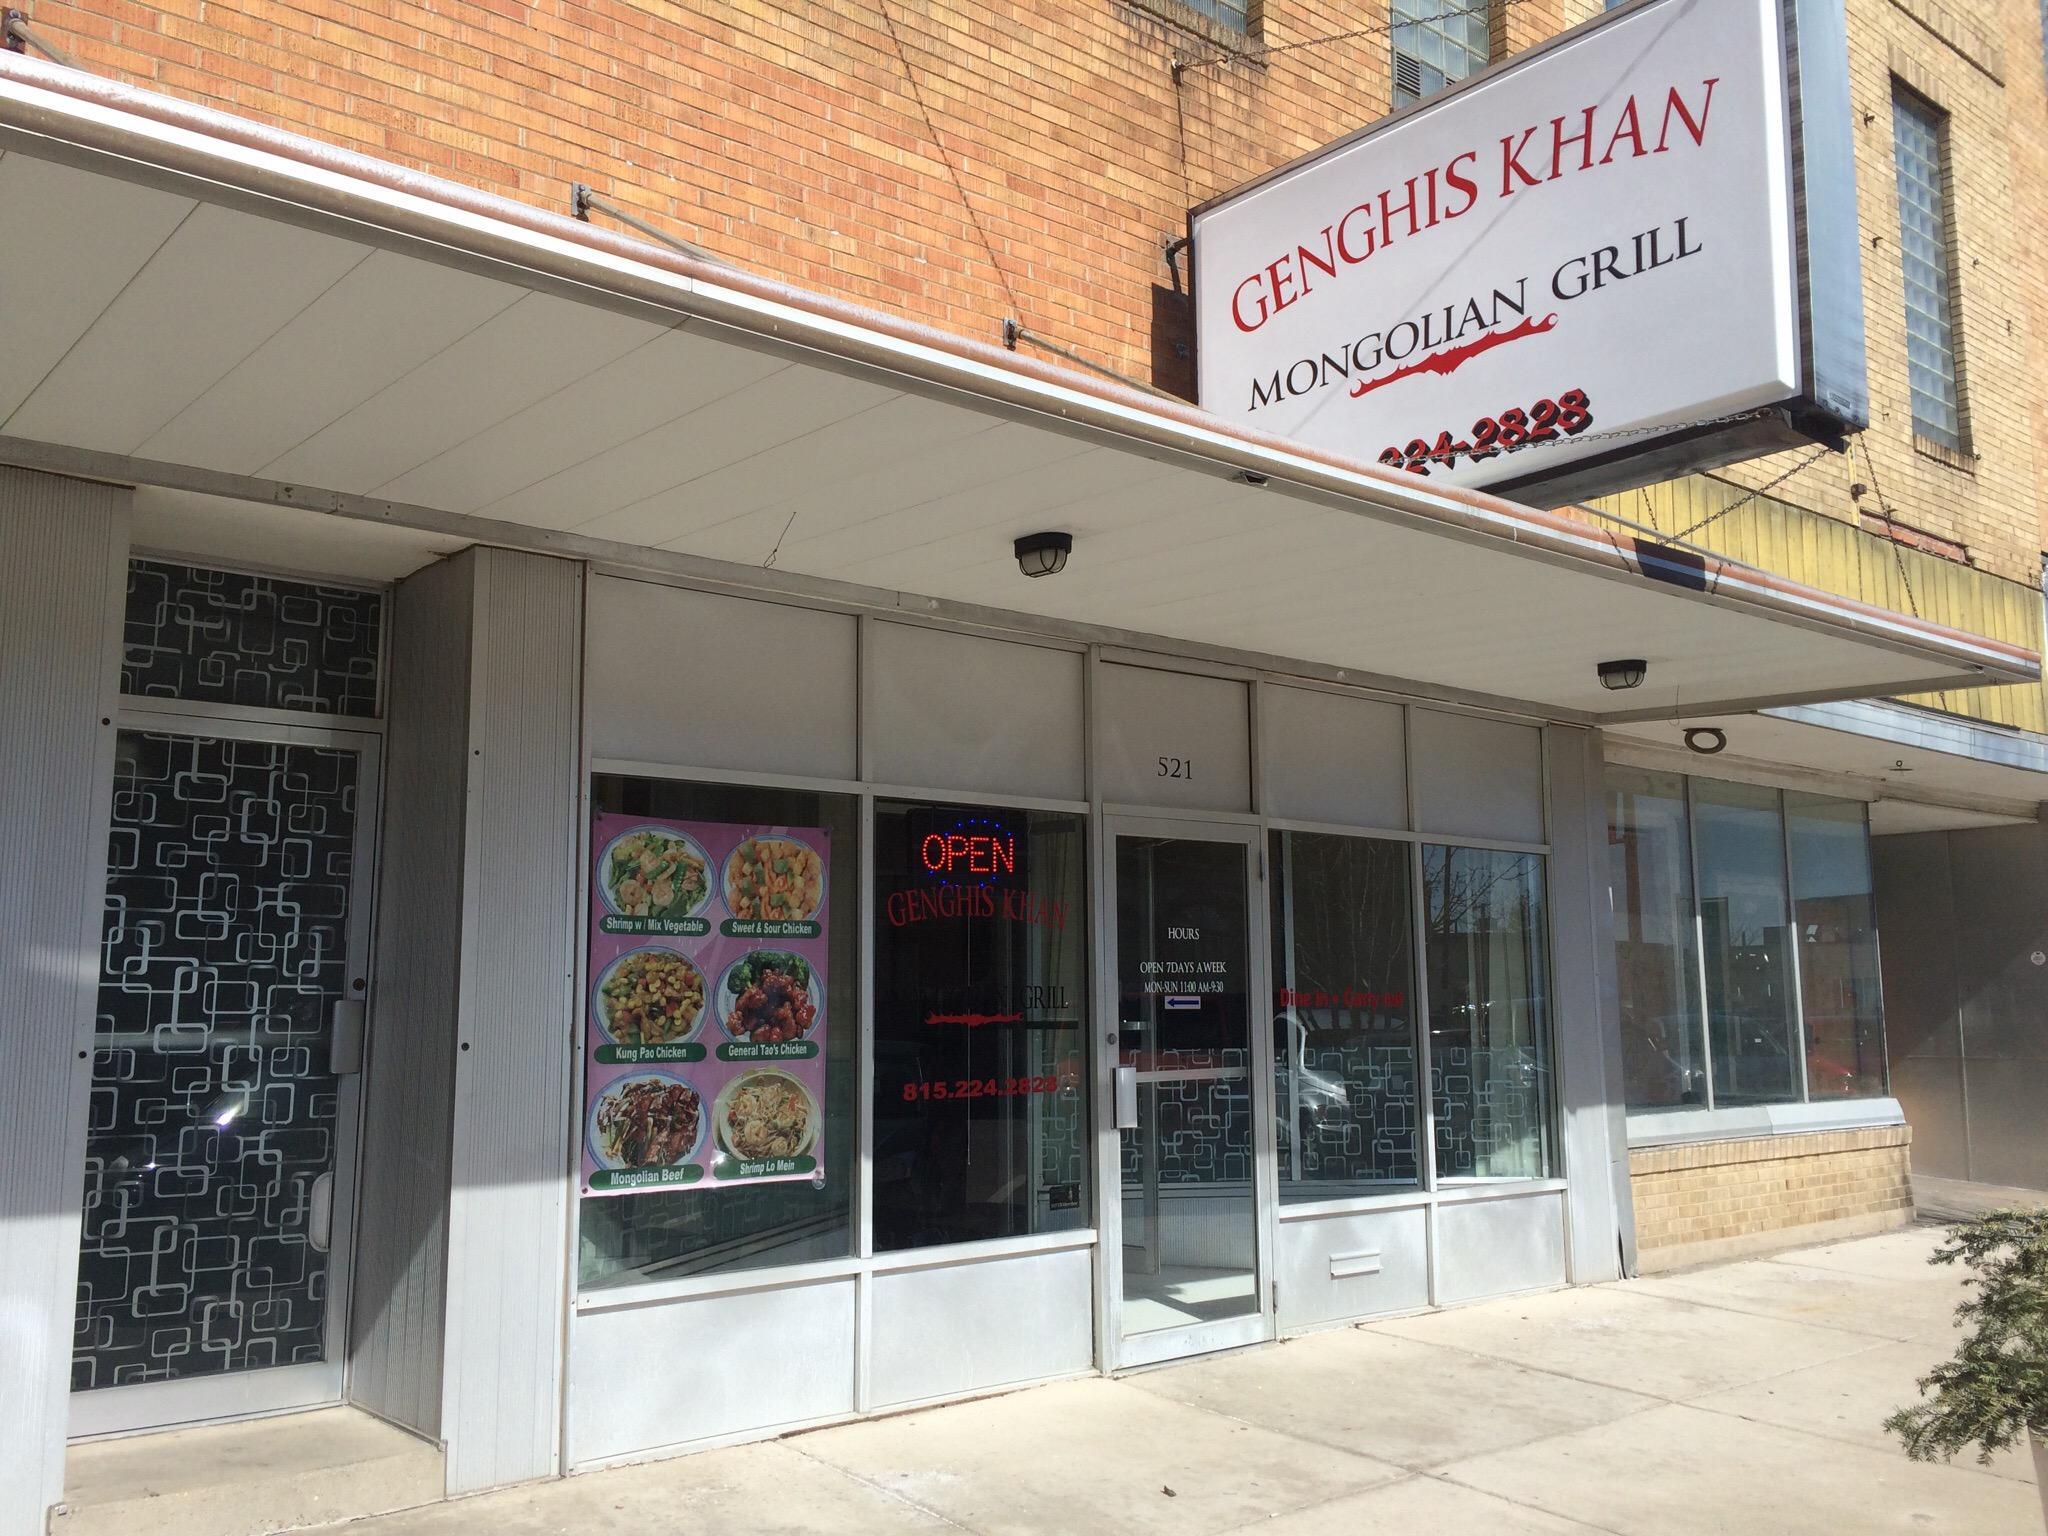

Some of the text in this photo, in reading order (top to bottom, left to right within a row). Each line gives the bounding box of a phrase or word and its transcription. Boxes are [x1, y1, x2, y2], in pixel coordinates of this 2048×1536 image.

[1230, 78, 1720, 333] GENGHIS KHAN
[1247, 216, 1702, 411] MONGOLIAN GRILL
[1157, 756, 1193, 780] 521
[922, 834, 1014, 873] OPEN
[887, 885, 1071, 930] GENGHIS KHAN
[606, 917, 634, 932] Shrimp
[647, 919, 662, 931] Mix
[664, 919, 704, 934] Vegetable
[732, 922, 812, 934] Sweet & Sour Chicken
[1168, 927, 1200, 940] HOURS
[1140, 961, 1164, 973] OPEN
[1144, 981, 1178, 993] MON-SUN
[1022, 985, 1069, 1010] GRILL
[615, 1047, 687, 1061] Kung Pao Chicken
[728, 1044, 808, 1057] General Tao's Chicken
[903, 1075, 1060, 1101] 815.224.2828
[740, 1160, 795, 1176] Shrimp Lo Mein
[610, 1168, 684, 1187] Mongolian Beef
